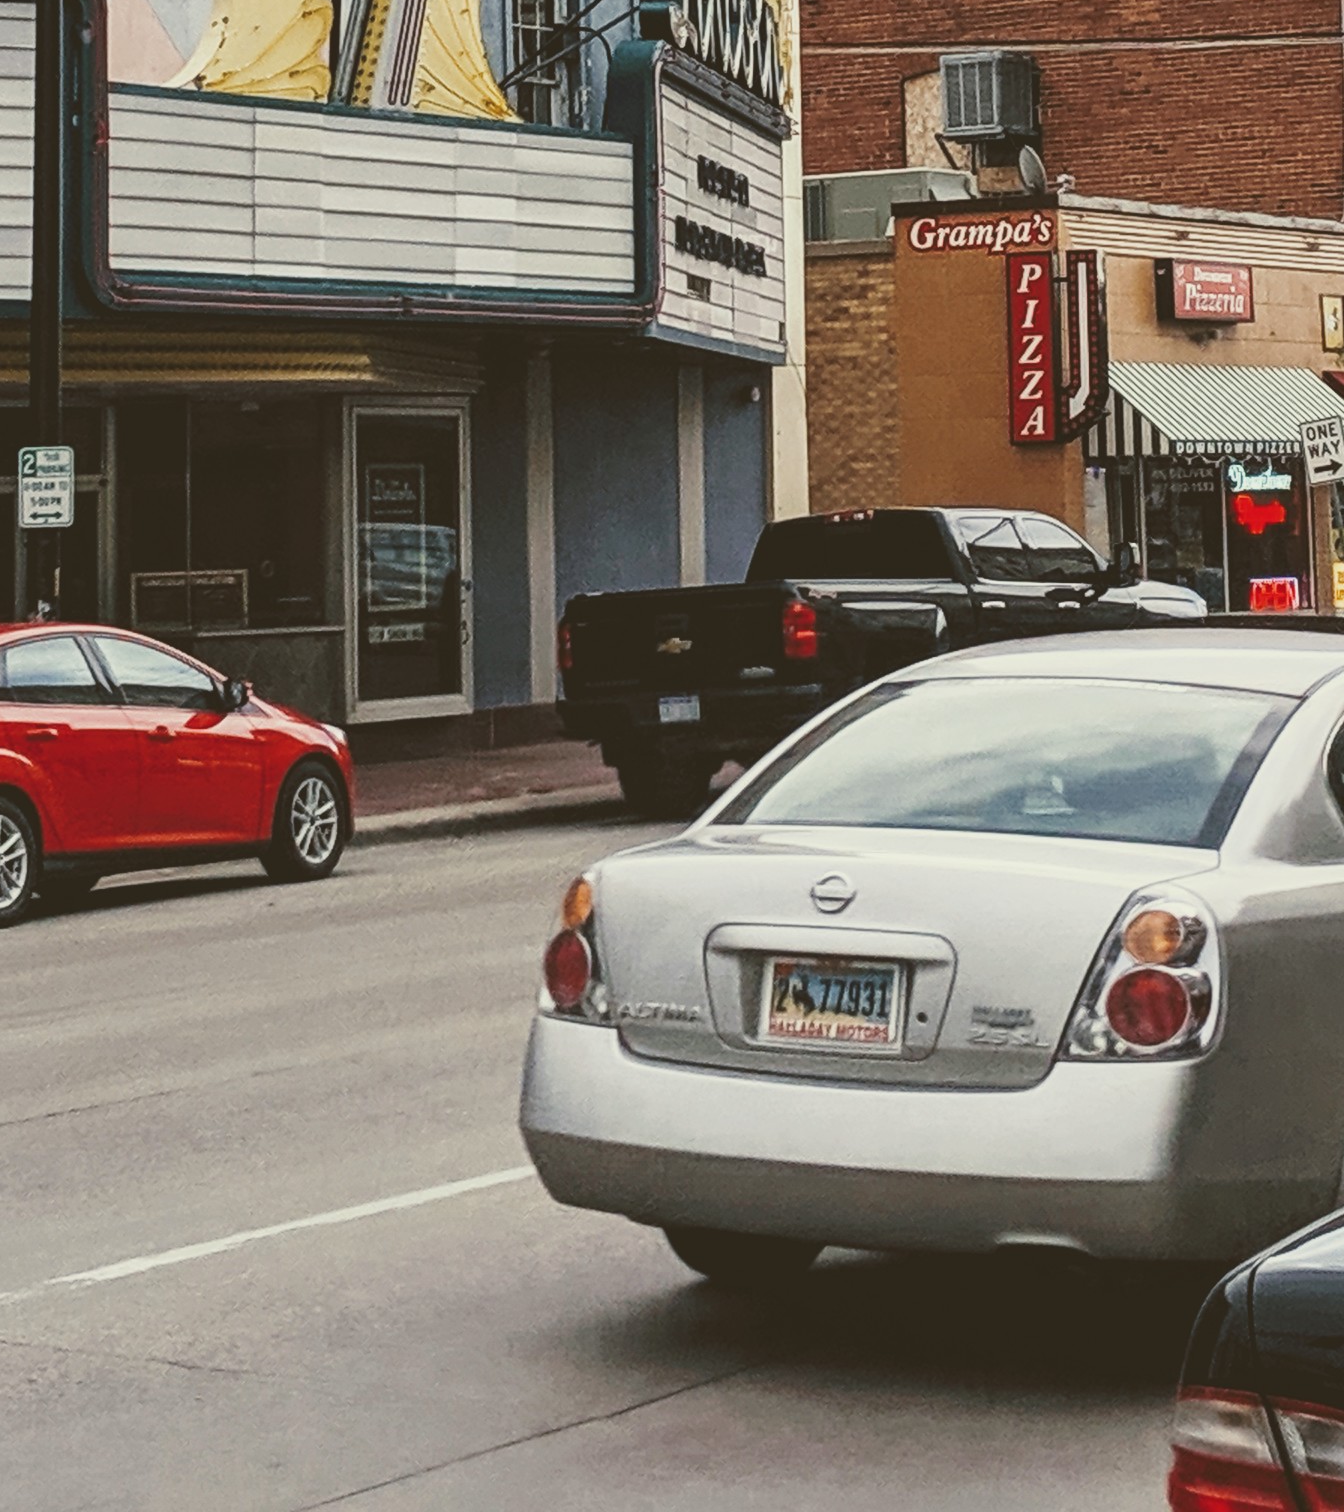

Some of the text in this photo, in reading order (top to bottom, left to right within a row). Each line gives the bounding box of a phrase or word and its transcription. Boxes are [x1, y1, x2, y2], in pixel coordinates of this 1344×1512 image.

[909, 214, 1053, 252] Grampa's
[1184, 282, 1245, 314] Pizzeria
[1016, 263, 1046, 436] PIZZA
[1306, 421, 1339, 442] ONE
[1175, 441, 1254, 455] DOWNTOWN
[1307, 439, 1342, 460] WAY
[23, 453, 35, 475] 2
[835, 1023, 890, 1044] MOTORS
